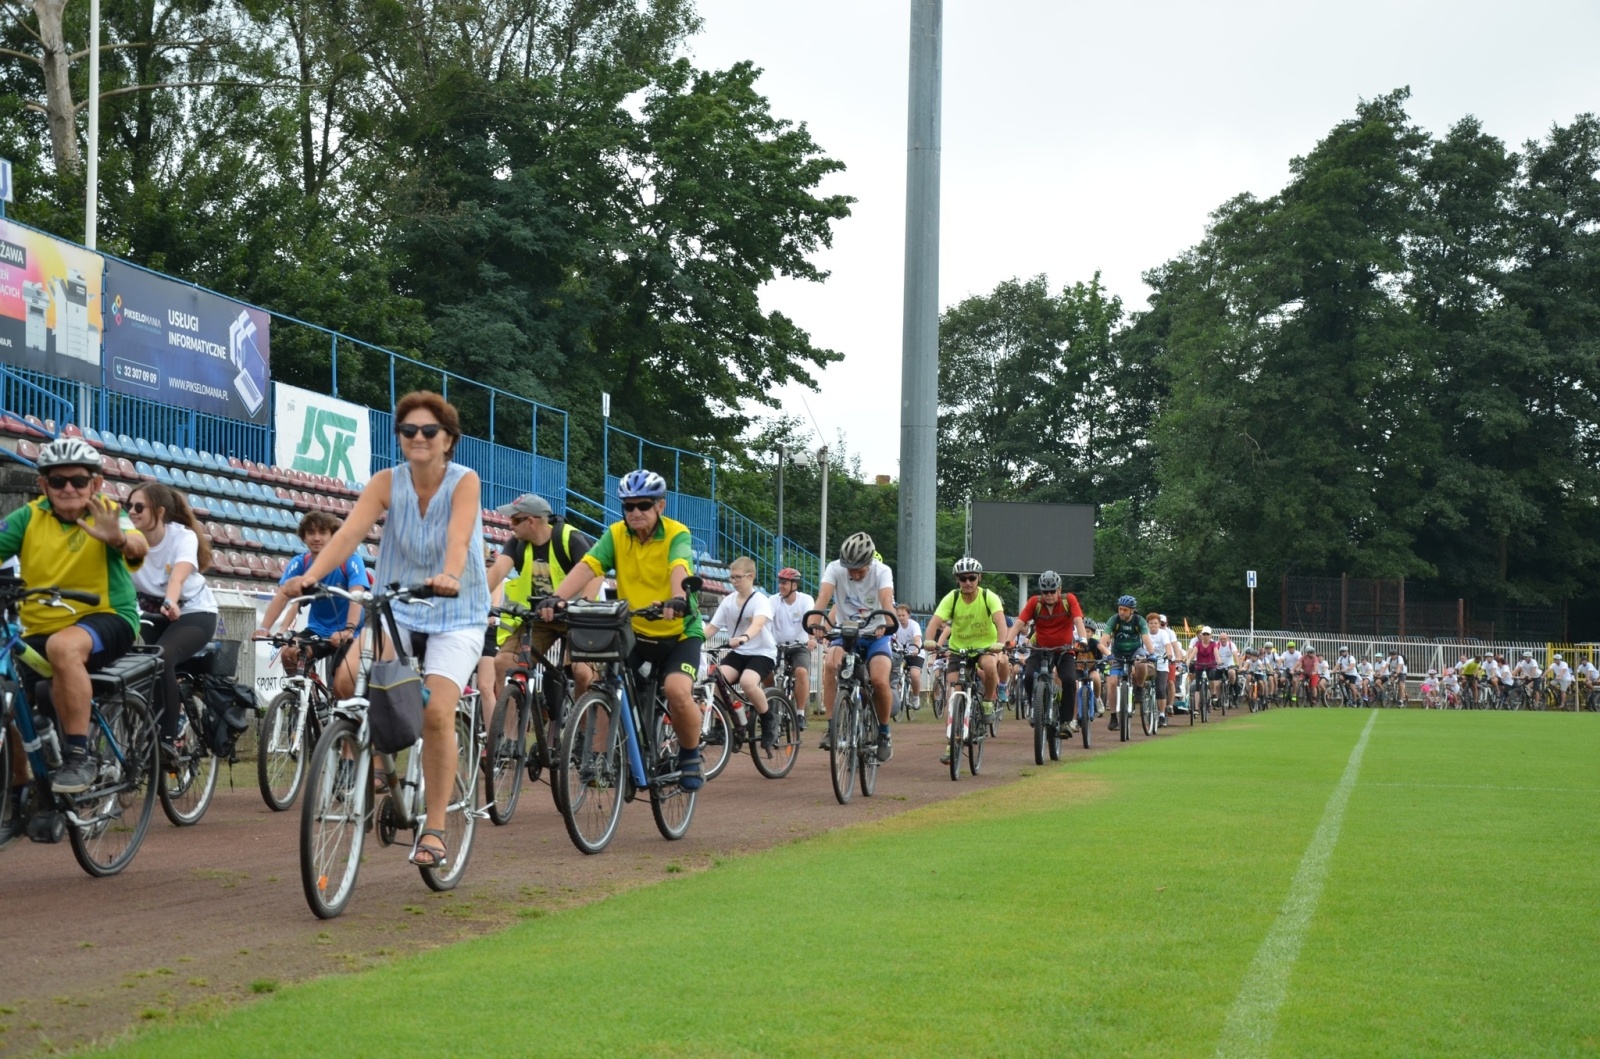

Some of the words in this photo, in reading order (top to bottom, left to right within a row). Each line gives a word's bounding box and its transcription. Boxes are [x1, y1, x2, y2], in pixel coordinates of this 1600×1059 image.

[124, 308, 161, 328] PIKSELOMANIA
[168, 309, 199, 332] USŁUGI
[168, 331, 227, 360] INFORMATYCZNE
[124, 365, 131, 377] 32
[132, 367, 142, 380] 307
[142, 370, 149, 382] 09
[150, 372, 157, 384] 09
[168, 377, 229, 401] WWW.PIKSELOMANIA.PL
[290, 405, 358, 483] JSK
[1248, 572, 1255, 586] H
[257, 677, 277, 691] SPORT
